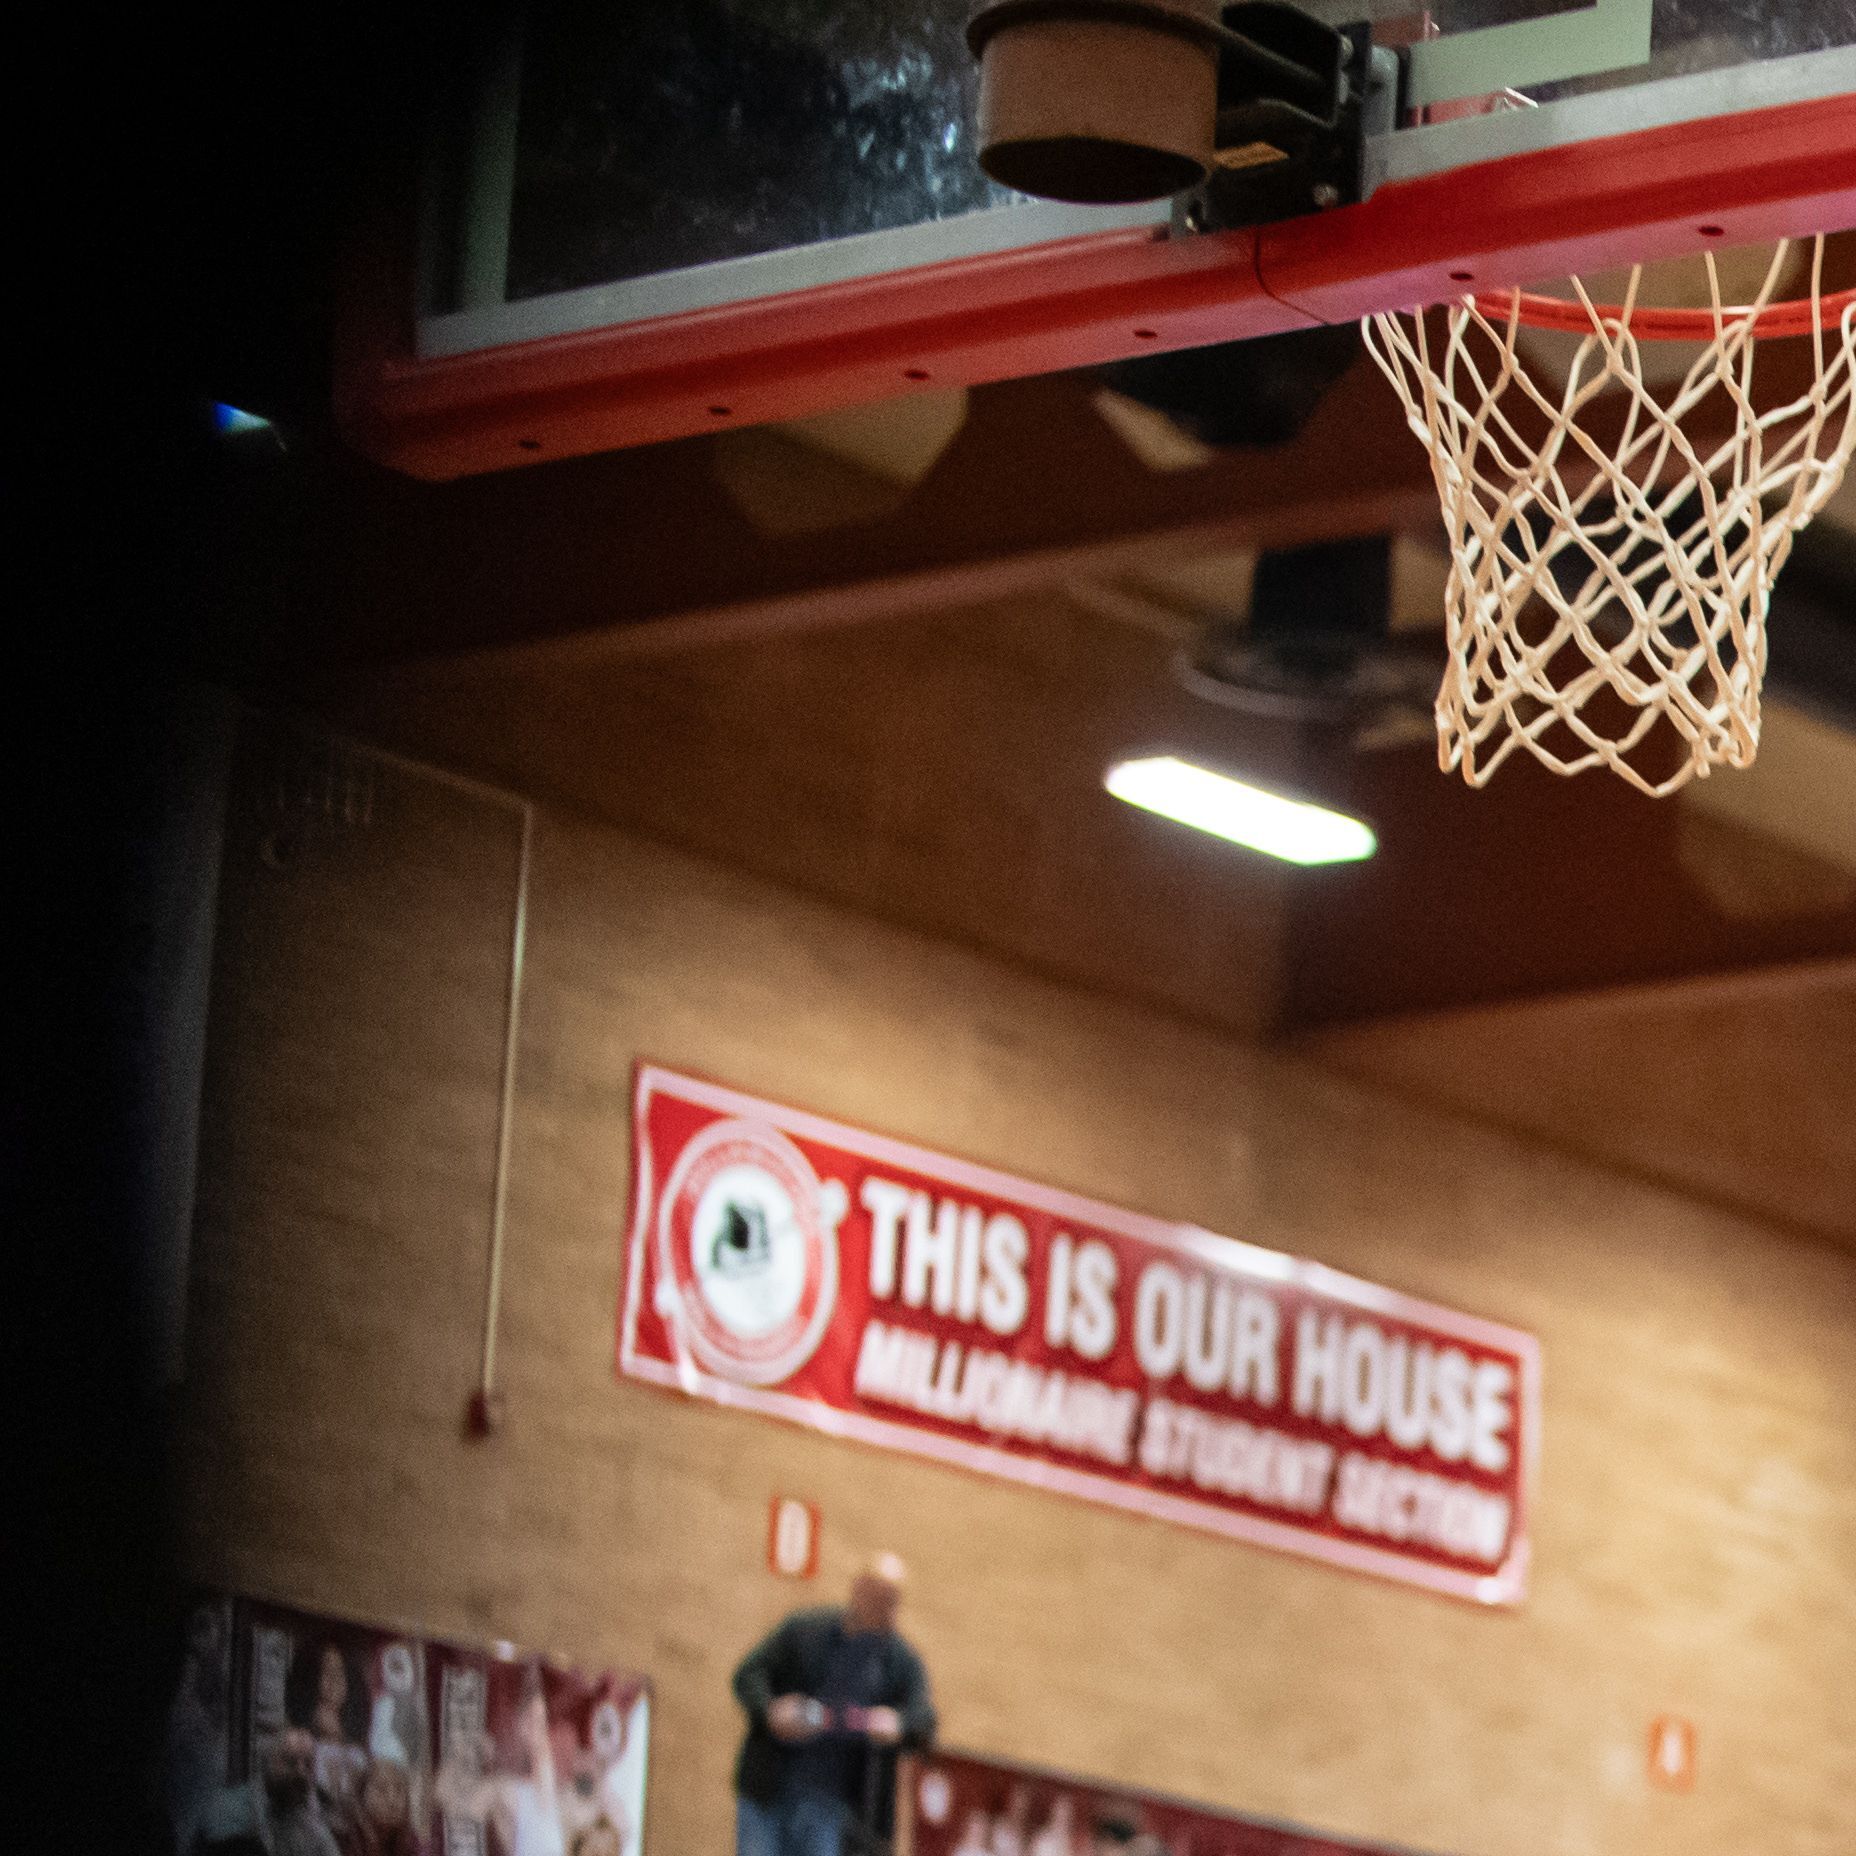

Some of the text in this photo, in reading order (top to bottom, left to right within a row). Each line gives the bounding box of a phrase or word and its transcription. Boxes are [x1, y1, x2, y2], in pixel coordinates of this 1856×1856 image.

[854, 1320, 1138, 1466] MILLIONAIRE
[1140, 1393, 1336, 1515] STUDENT
[861, 1176, 1511, 1471] THIS IS OUR HOUSE
